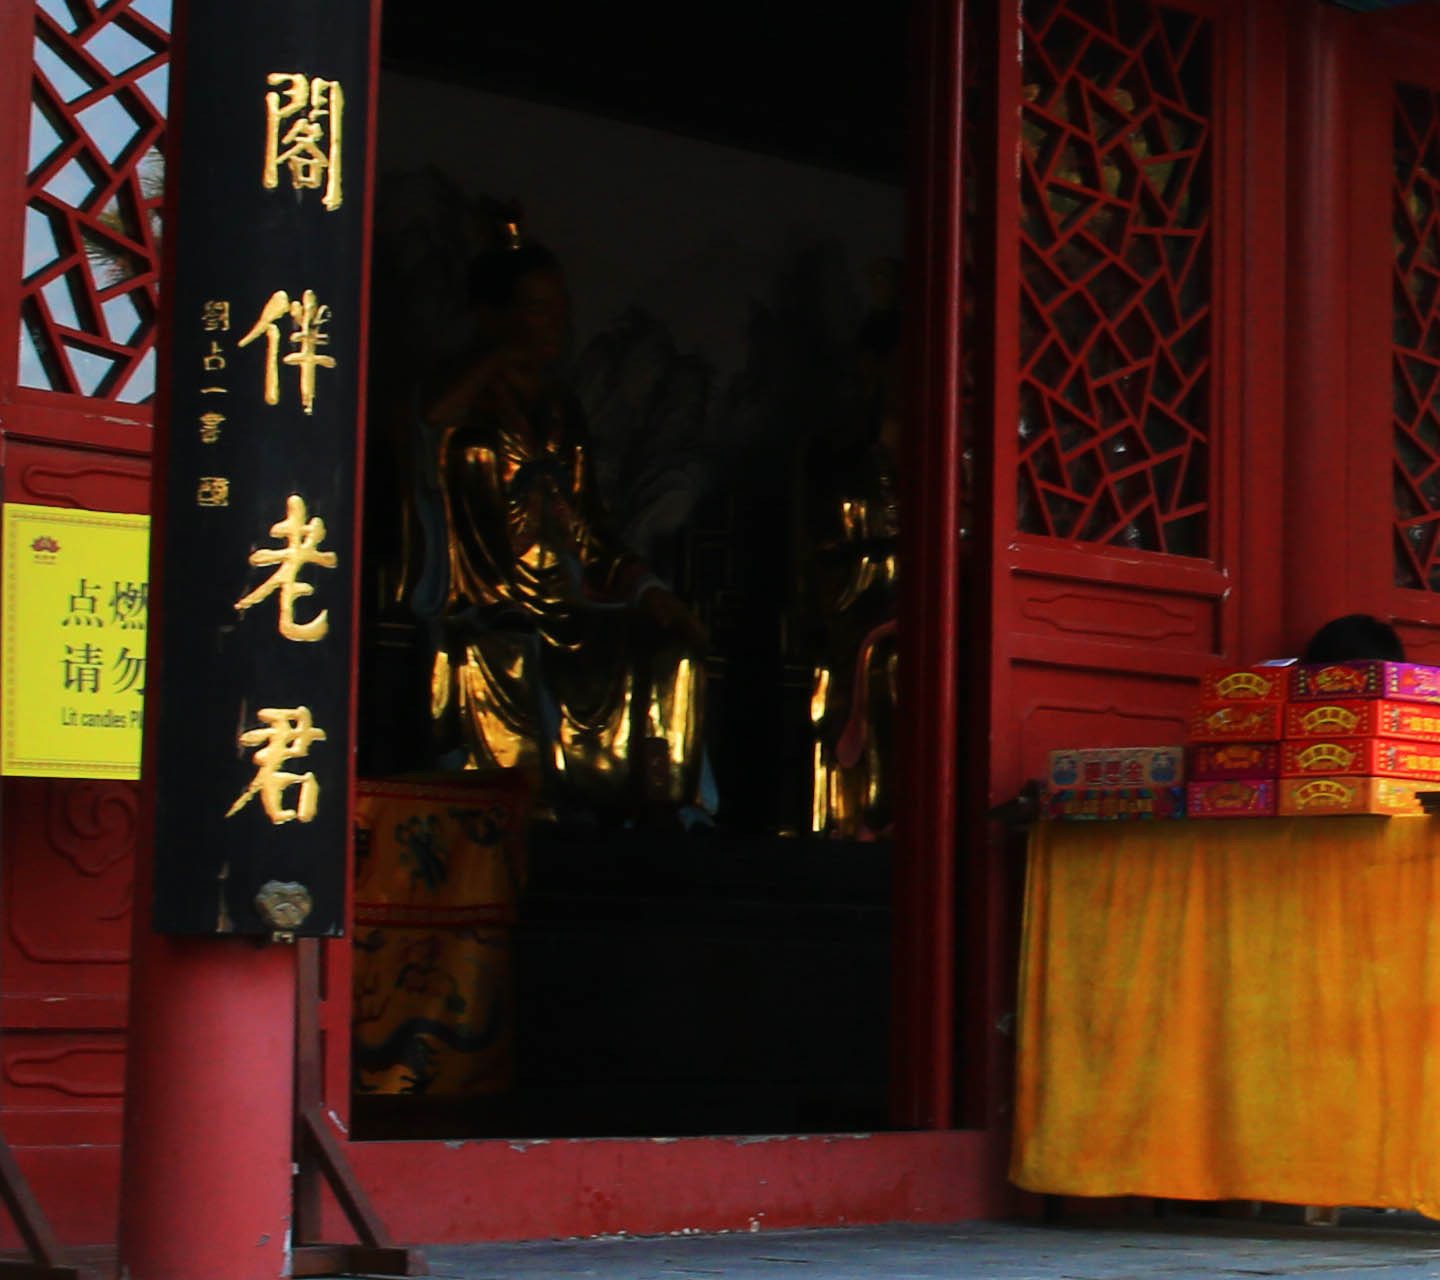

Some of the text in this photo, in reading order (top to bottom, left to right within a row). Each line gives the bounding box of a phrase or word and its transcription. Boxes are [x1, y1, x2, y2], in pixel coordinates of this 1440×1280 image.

[60, 578, 148, 631] 点燃
[60, 642, 146, 695] 请勿
[60, 706, 78, 727] Lit
[79, 708, 127, 729] candles
